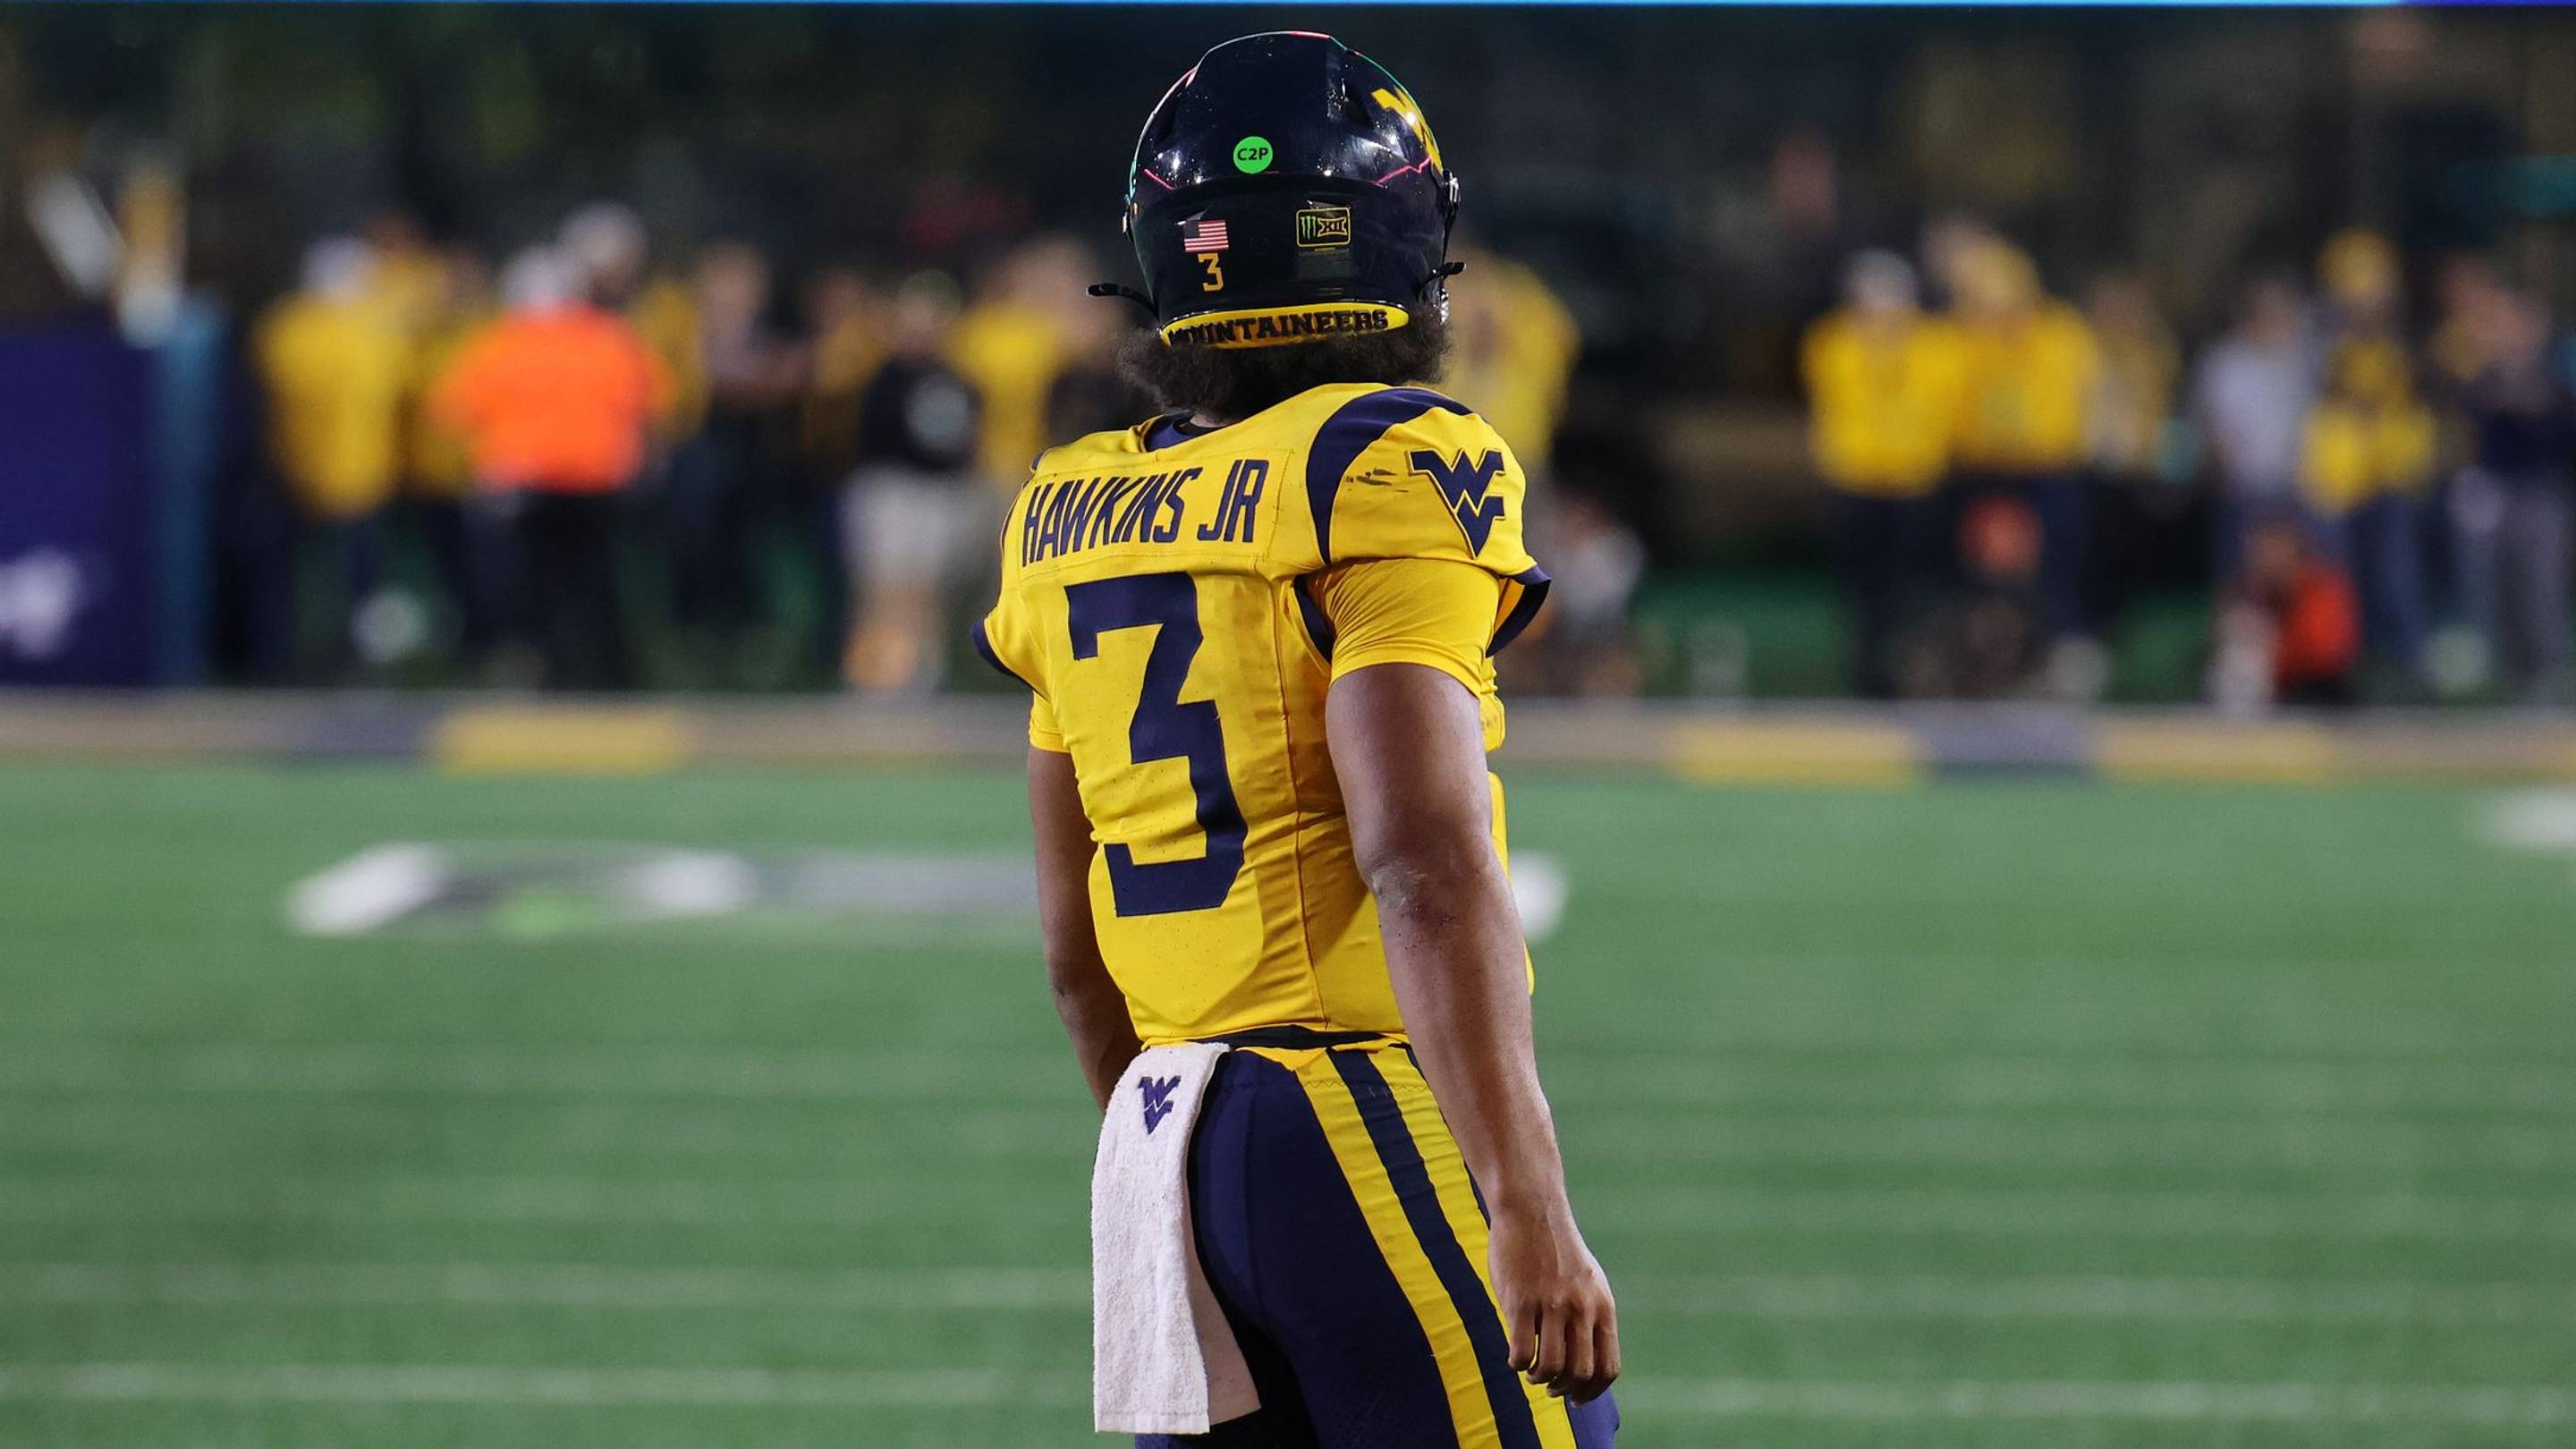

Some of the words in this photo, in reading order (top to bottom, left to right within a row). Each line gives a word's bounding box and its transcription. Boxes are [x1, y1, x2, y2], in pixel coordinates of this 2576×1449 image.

[1237, 148, 1268, 161] C2P
[1197, 252, 1224, 292] 3
[1021, 466, 1203, 568] HAWKINS
[1196, 459, 1269, 544] JR
[1063, 571, 1249, 918] 3
